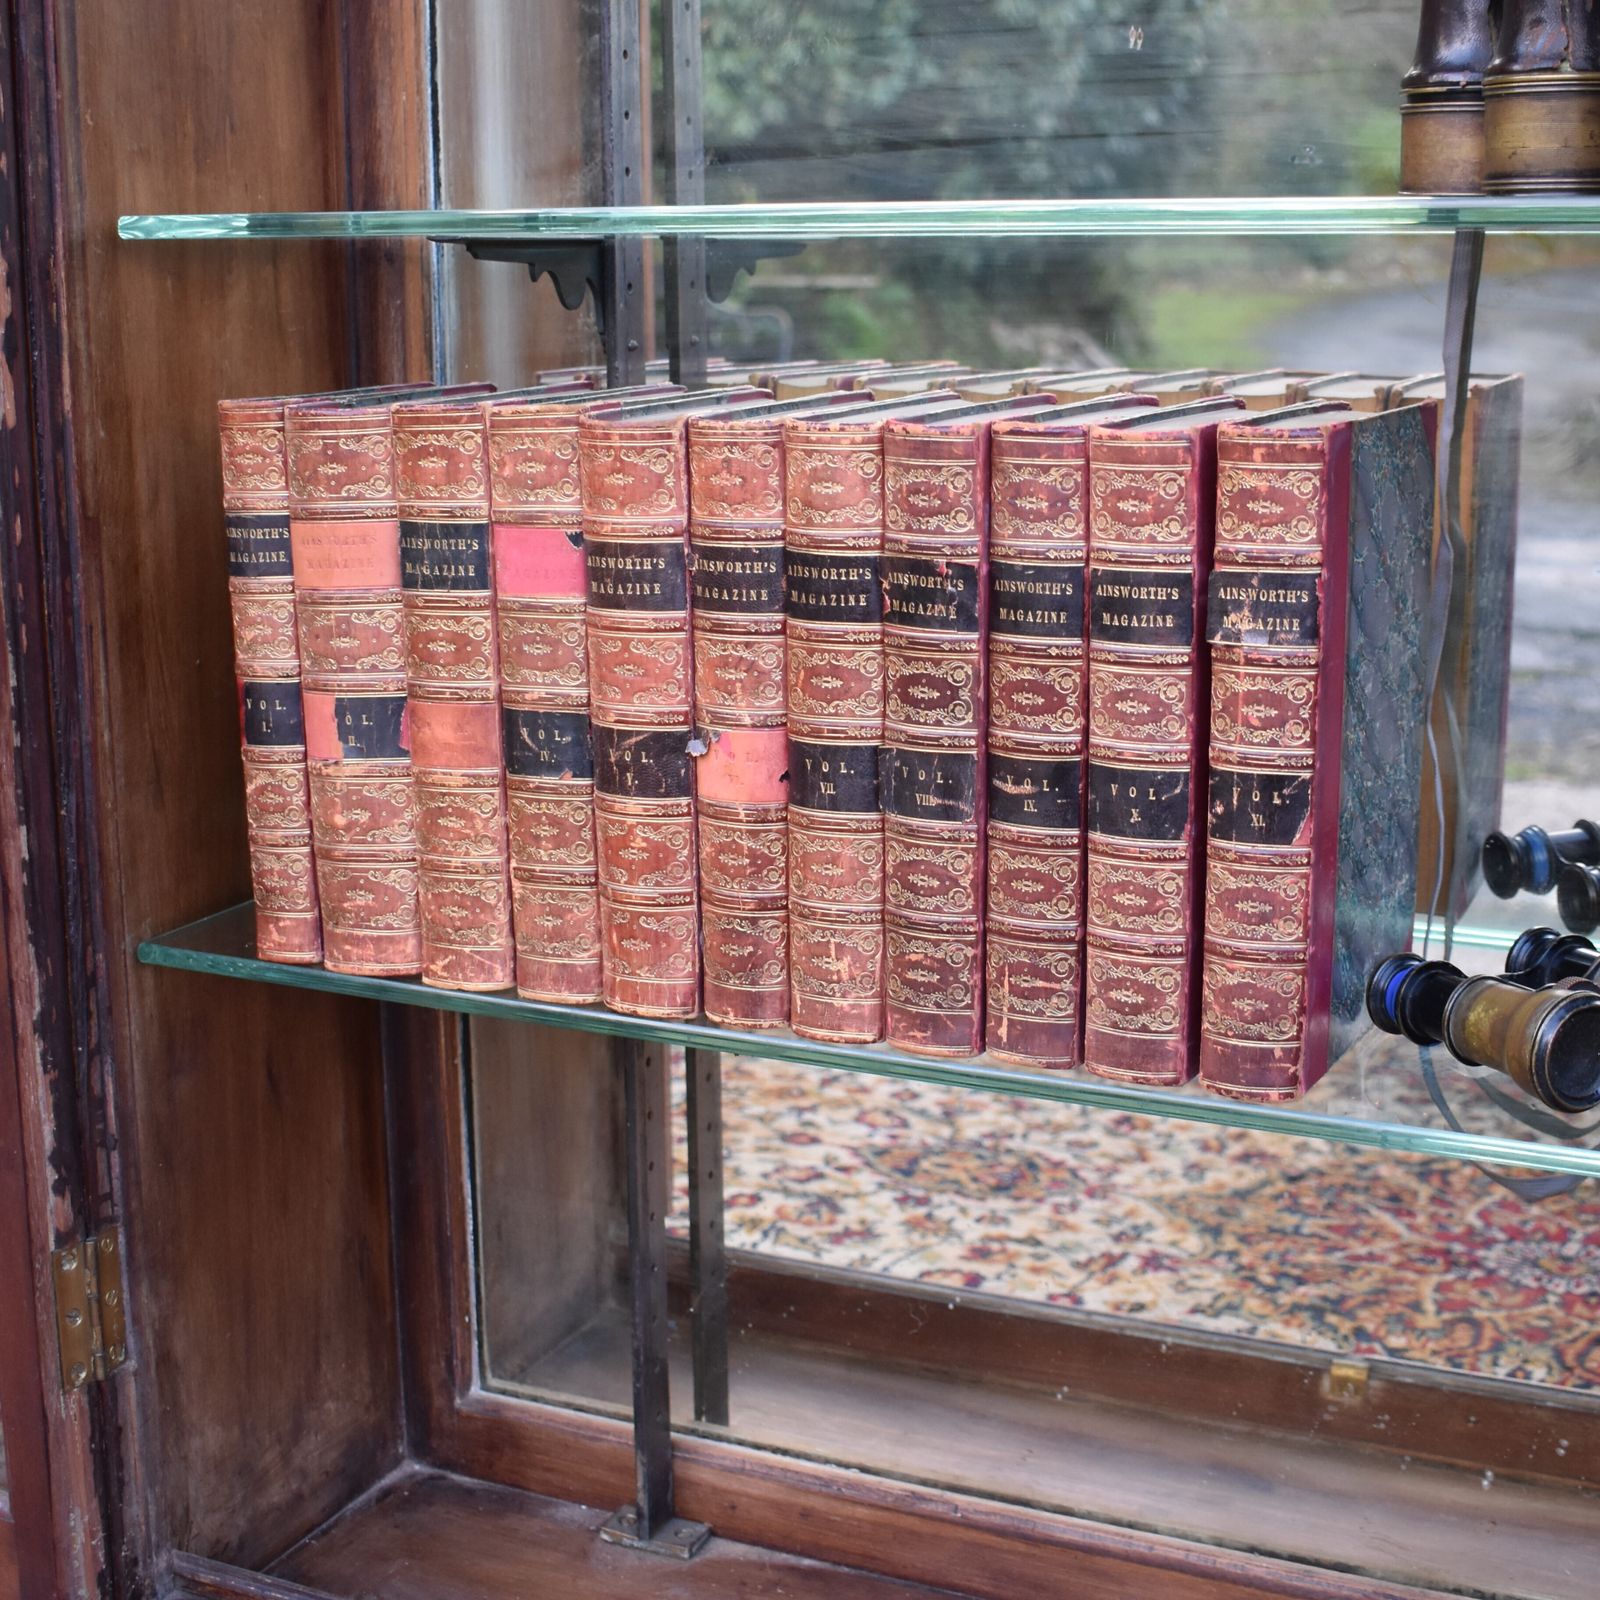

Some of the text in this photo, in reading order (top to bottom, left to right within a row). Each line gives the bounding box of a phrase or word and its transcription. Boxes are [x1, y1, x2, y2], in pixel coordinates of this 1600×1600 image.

[401, 538, 479, 550] AINSWORTH'S
[405, 562, 476, 576] MAGAZINE
[587, 556, 666, 570] AINSWORTH'S
[693, 559, 777, 573] AINSWORTH'S
[787, 564, 872, 580] AINSWORTH'S
[591, 581, 662, 594] MAGAZINE
[887, 571, 965, 591] AINSWORTH'S
[994, 579, 1074, 595] AINSWORTH'S
[695, 585, 769, 601] MAGAZINE
[790, 590, 867, 606] MAGAZINE
[1096, 584, 1180, 600] AINSWORTH'S
[1218, 587, 1309, 603] AINSWORTH'S
[892, 599, 957, 619] MAGAZINE
[999, 607, 1067, 624] MAGAZINE
[1102, 612, 1175, 628] MAGAZINE
[1222, 615, 1300, 631] MAGAZINE
[805, 758, 855, 774] VOL.
